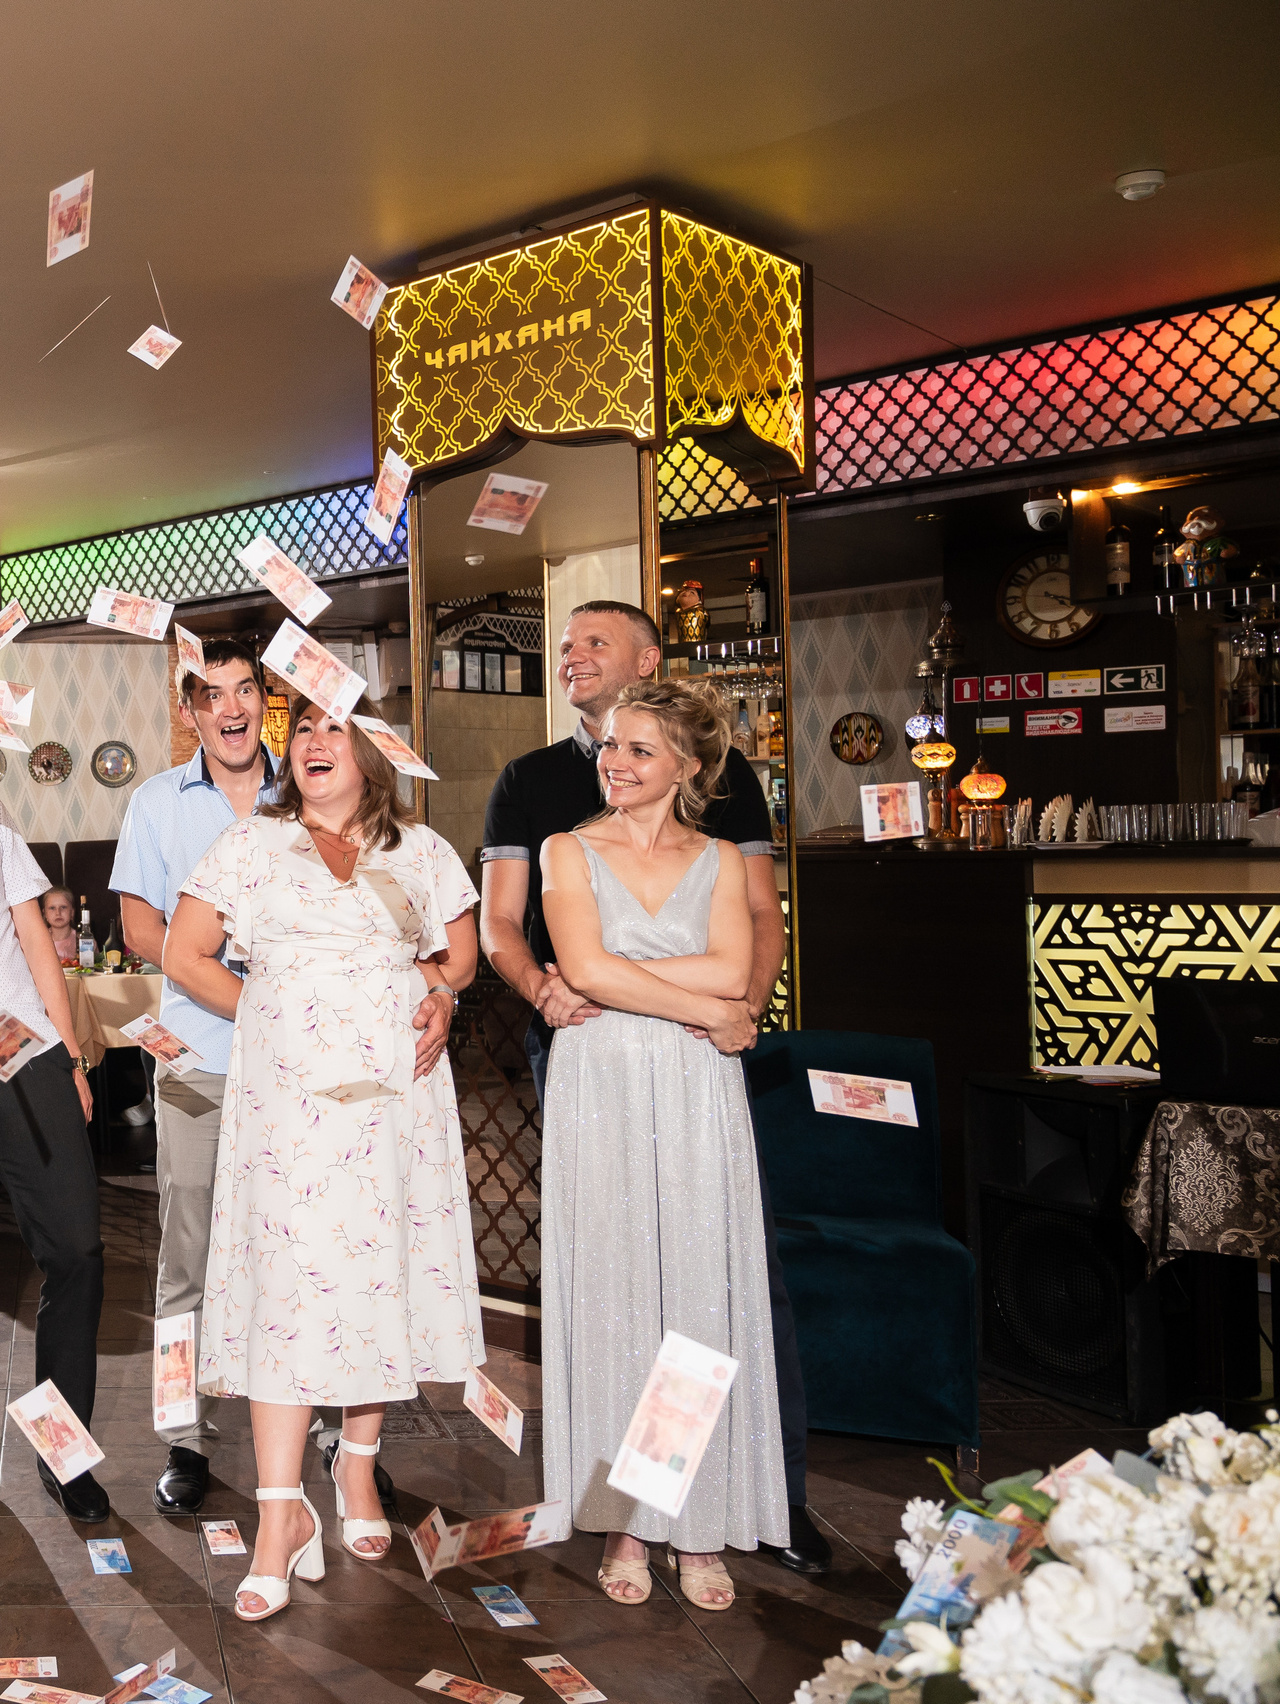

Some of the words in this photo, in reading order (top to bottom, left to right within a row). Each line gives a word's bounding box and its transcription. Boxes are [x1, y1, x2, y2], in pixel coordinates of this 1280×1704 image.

[424, 308, 592, 369] ЧАЙХАНА
[1049, 622, 1060, 639] 6
[1026, 728, 1082, 737] ВИДЕОНАБЛЮДЕНИЕ
[936, 1518, 969, 1560] 2000
